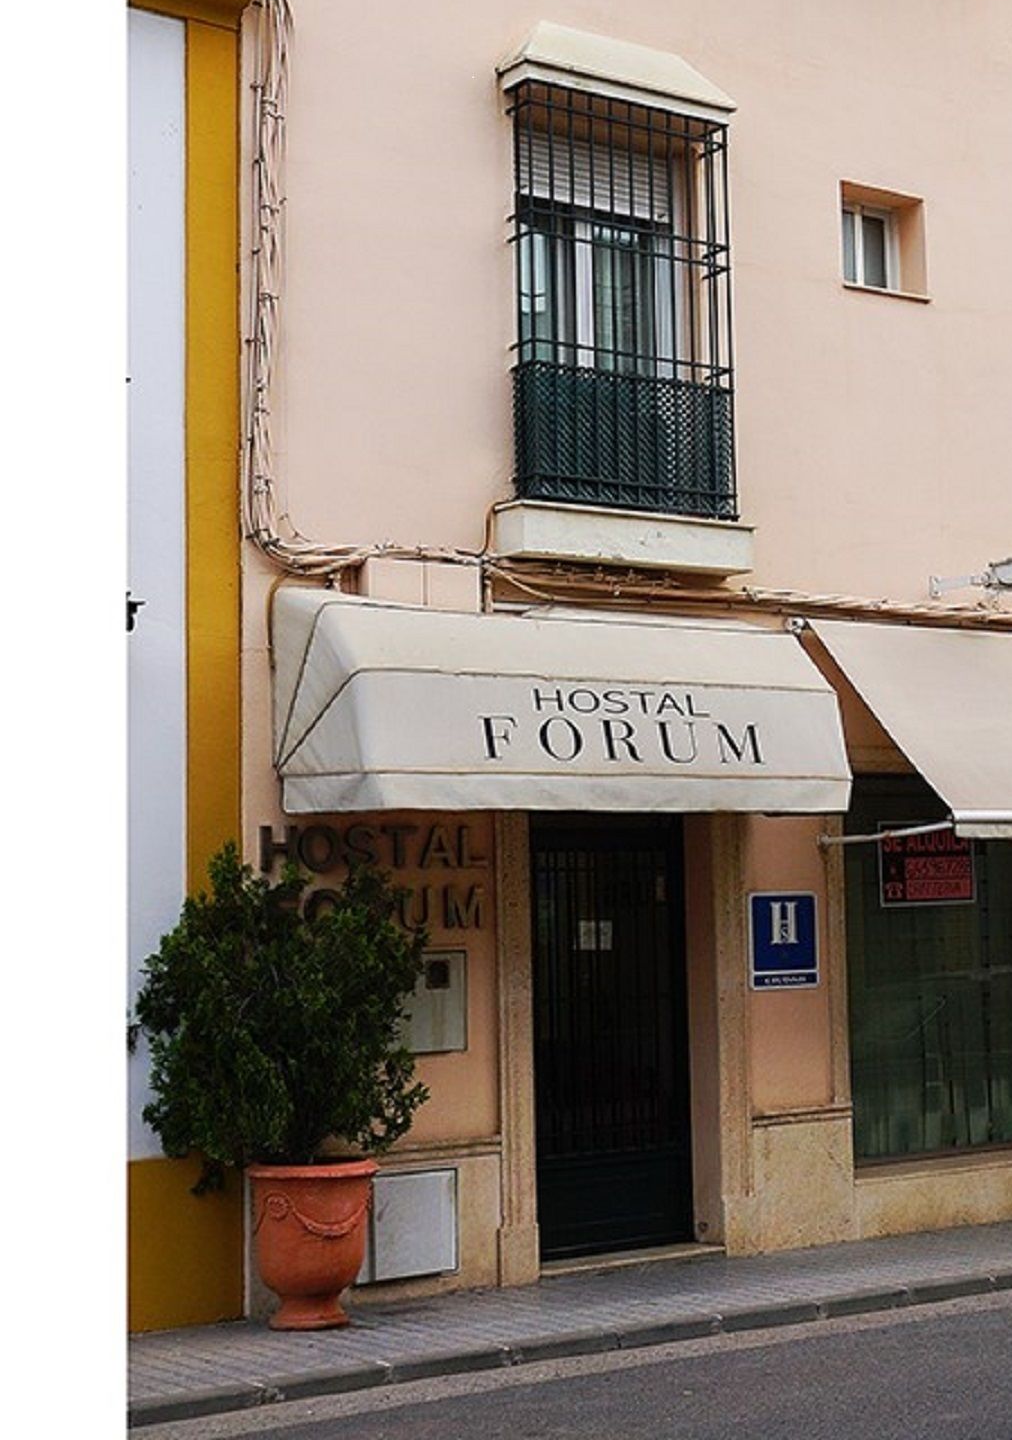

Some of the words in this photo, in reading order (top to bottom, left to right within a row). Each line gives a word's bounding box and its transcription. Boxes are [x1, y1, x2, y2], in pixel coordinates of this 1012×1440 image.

[532, 688, 711, 718] HOSTAL
[477, 715, 766, 765] FORUM
[258, 823, 488, 874] HOSTAL
